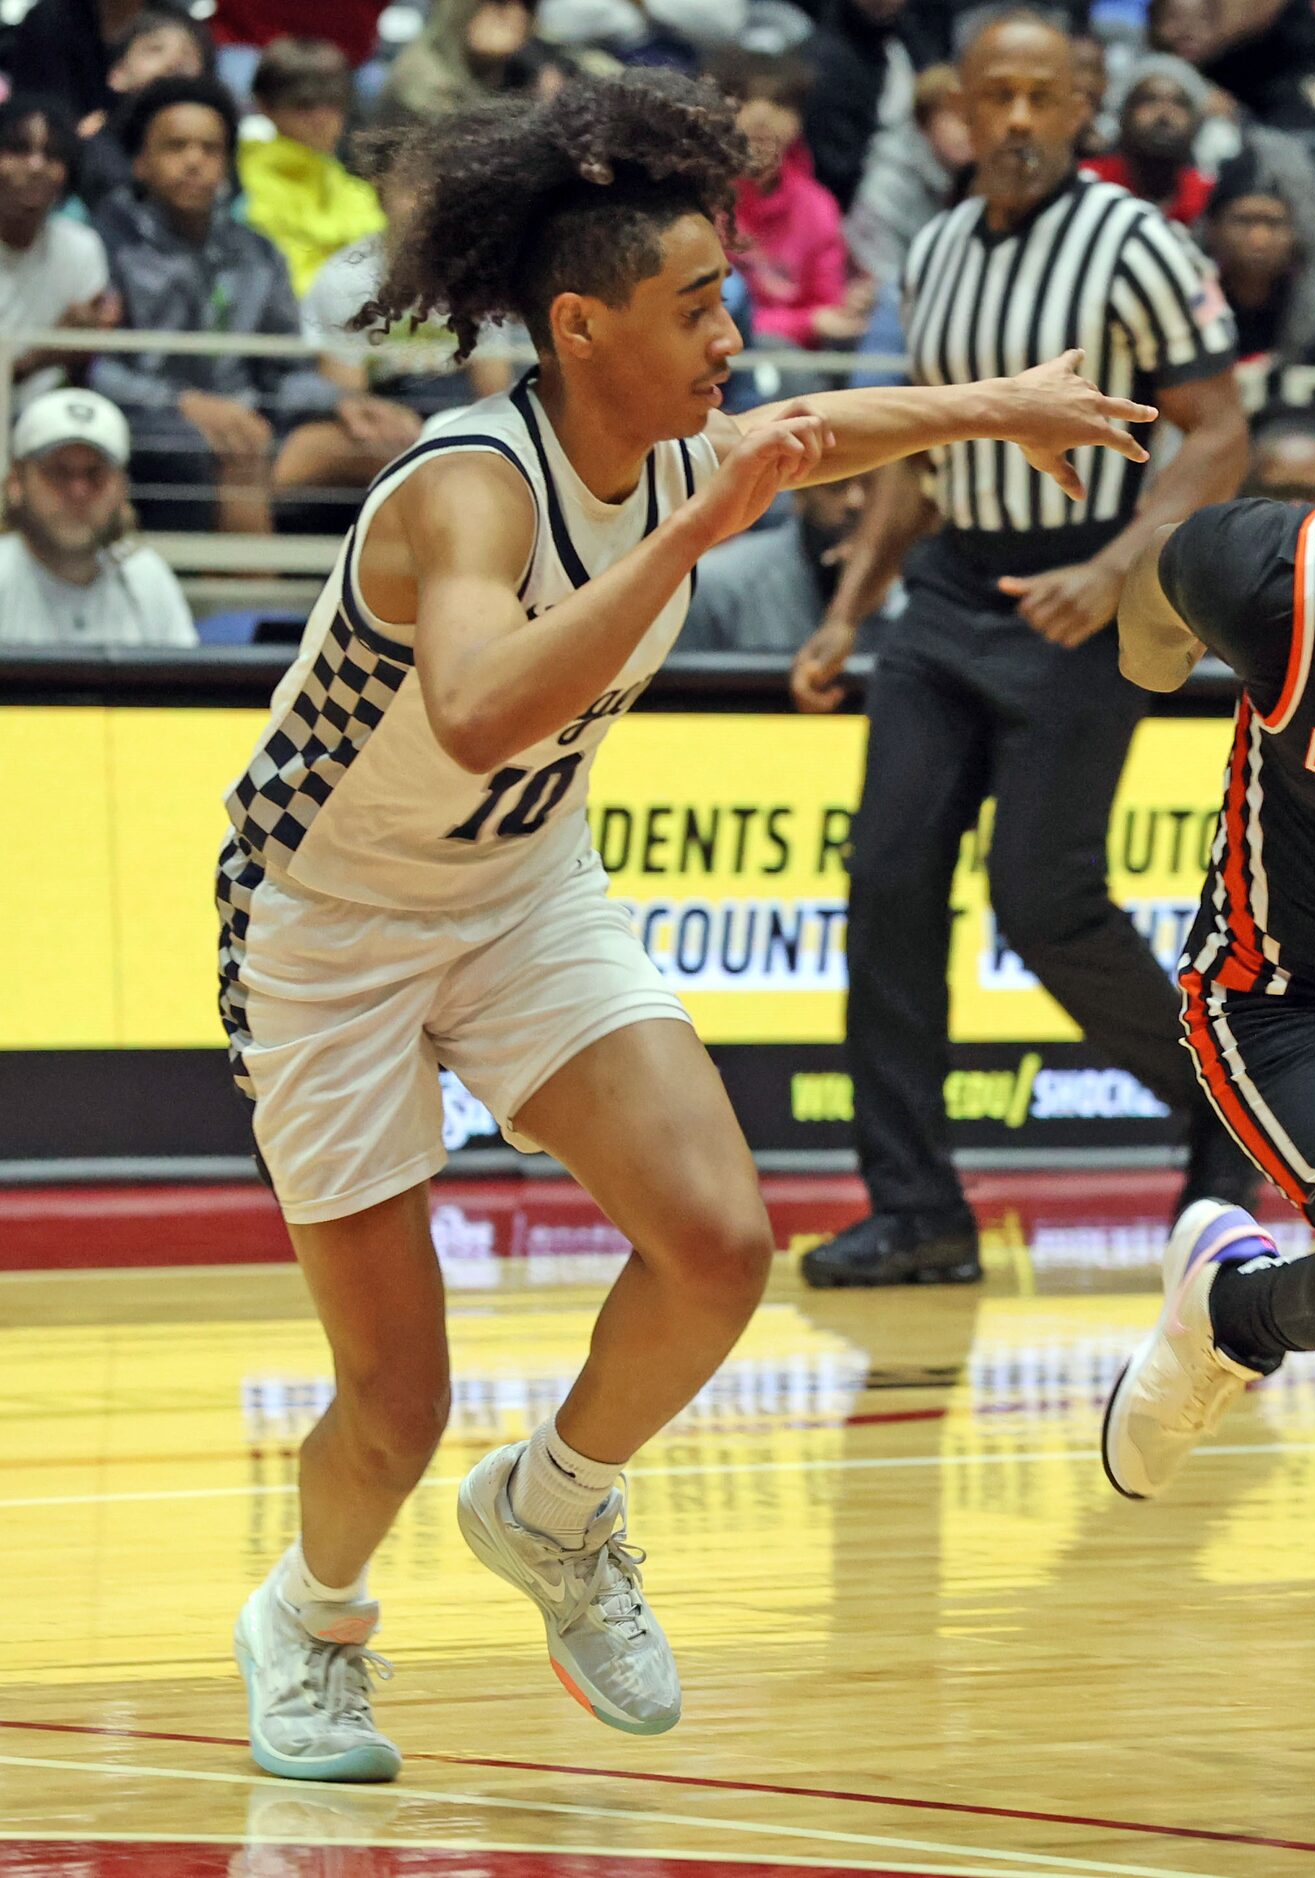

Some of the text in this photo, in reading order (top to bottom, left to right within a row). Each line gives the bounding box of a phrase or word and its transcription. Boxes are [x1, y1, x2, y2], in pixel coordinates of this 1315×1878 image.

[440, 750, 584, 840] 10
[587, 806, 791, 874] DENTS
[627, 905, 849, 974] COUNT
